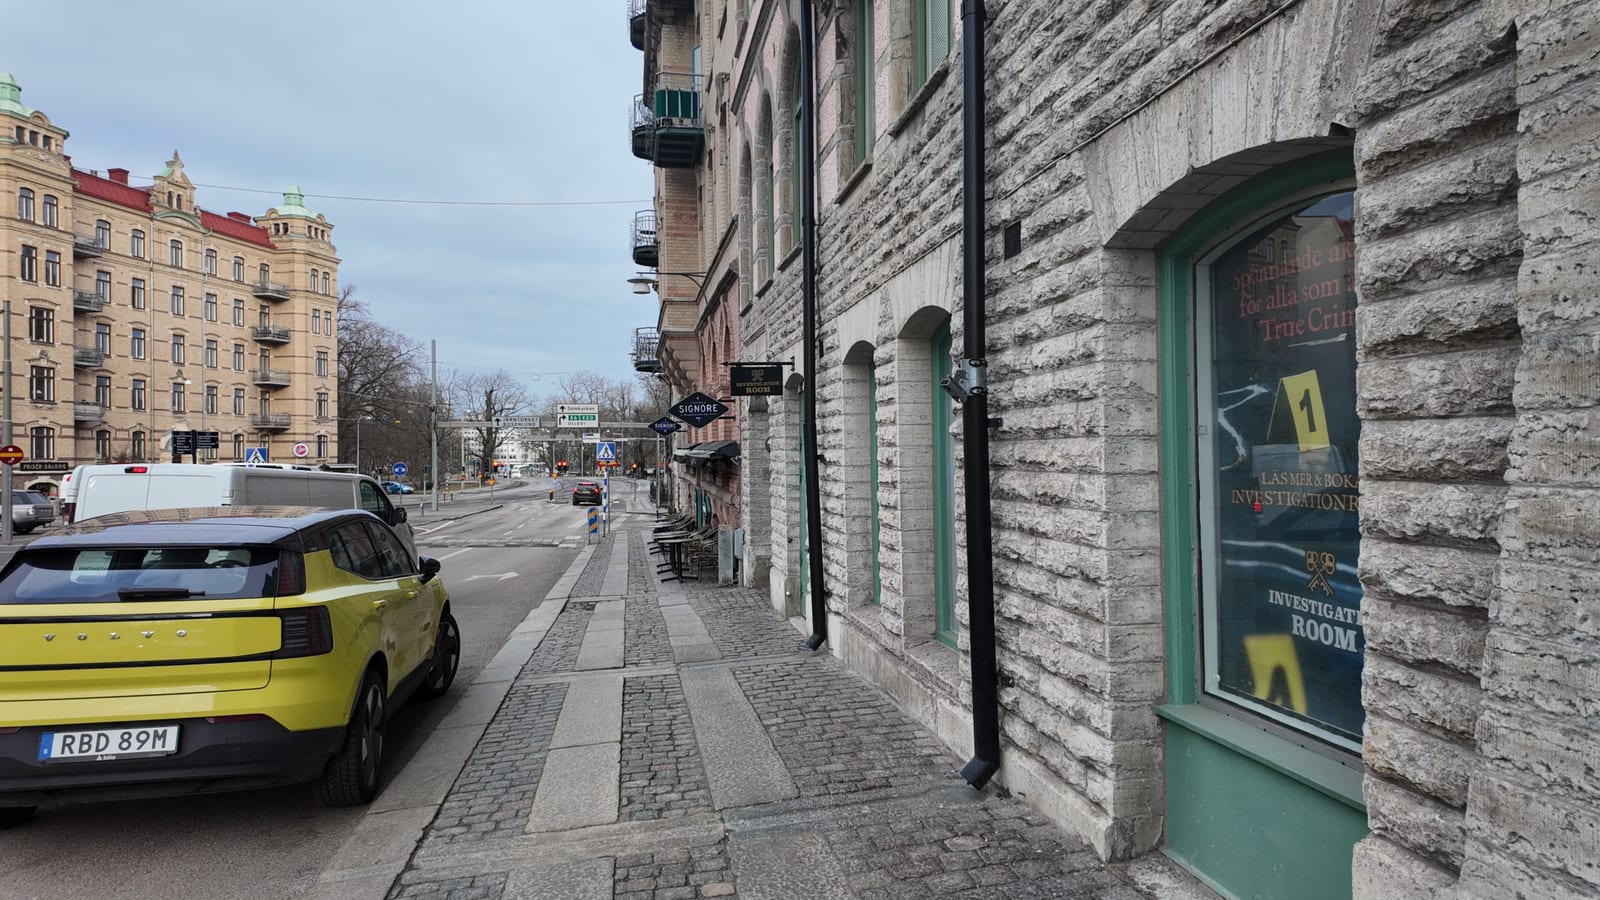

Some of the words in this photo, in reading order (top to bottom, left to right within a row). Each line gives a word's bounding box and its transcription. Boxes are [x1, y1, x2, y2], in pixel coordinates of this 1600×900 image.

[1266, 284, 1298, 309] alla
[1302, 278, 1340, 301] som
[1260, 317, 1304, 341] True
[679, 403, 718, 413] SIGNORE
[1299, 388, 1316, 432] 1
[1261, 469, 1288, 485] LÄS
[1289, 472, 1313, 487] MER
[1314, 475, 1322, 487] &
[43, 629, 188, 642] VOLVO
[1291, 614, 1357, 653] ROOM
[60, 733, 110, 755] RBD
[118, 729, 168, 751] 89M
